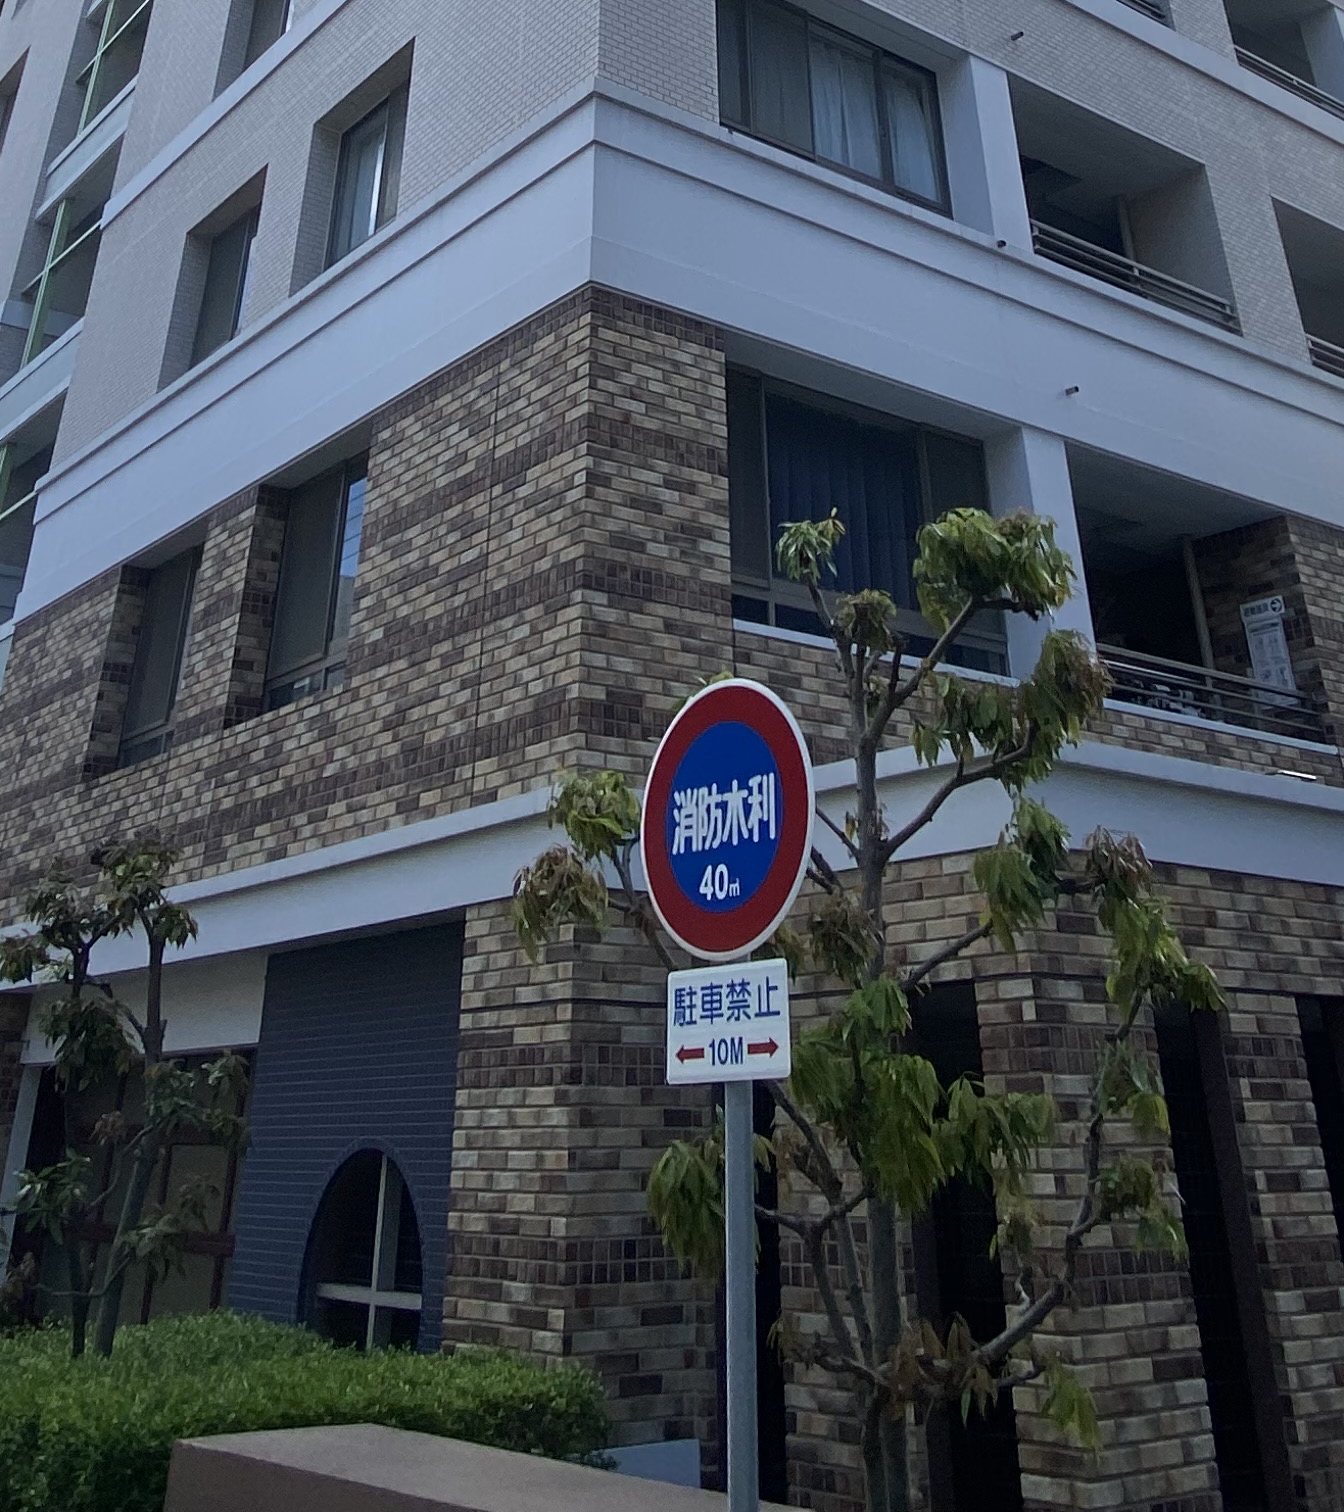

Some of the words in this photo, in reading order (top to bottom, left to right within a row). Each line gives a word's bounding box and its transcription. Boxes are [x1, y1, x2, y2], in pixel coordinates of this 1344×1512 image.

[672, 772, 775, 855] 消防水利
[673, 976, 780, 1027] 駐車禁止
[709, 1037, 743, 1066] 10M
